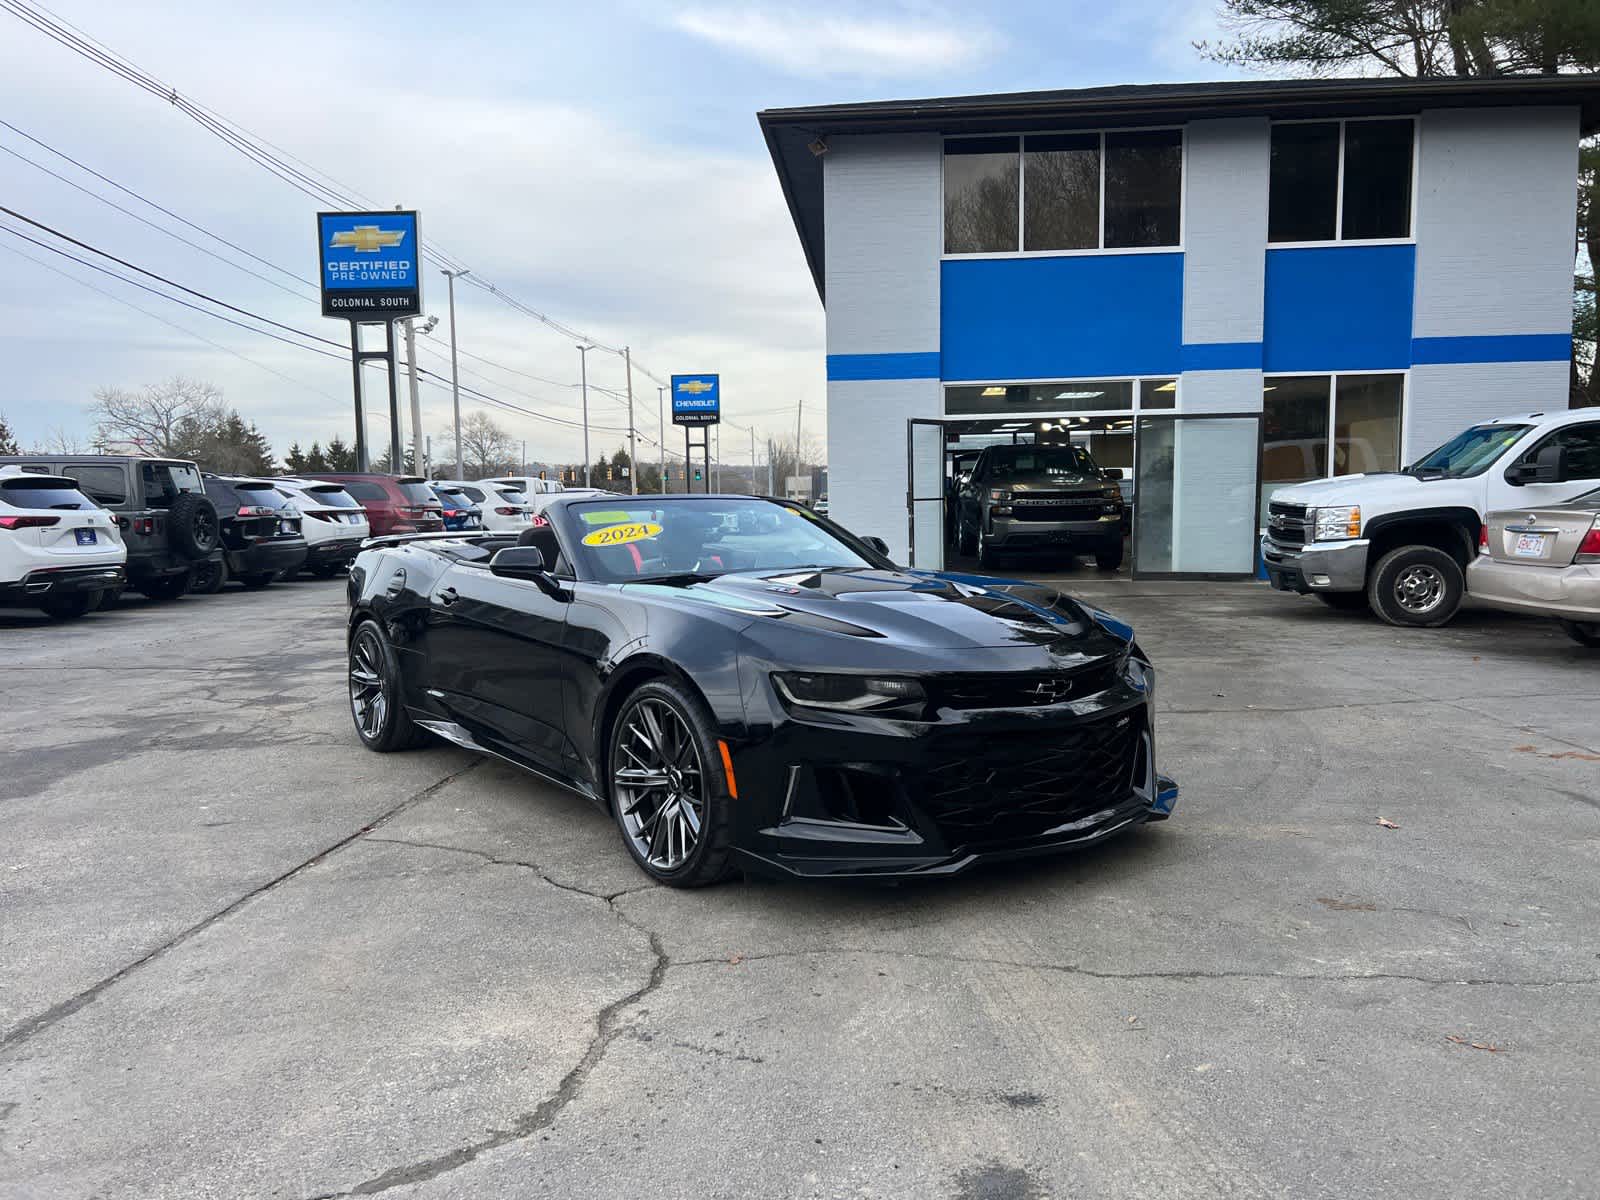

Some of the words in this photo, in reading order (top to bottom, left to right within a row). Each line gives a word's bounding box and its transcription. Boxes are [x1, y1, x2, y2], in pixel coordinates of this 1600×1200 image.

[327, 260, 410, 271] CERTIFIED
[332, 270, 407, 280] PRE-OWNED
[331, 298, 376, 307] COLONIAL
[380, 297, 409, 306] SOUTH
[599, 524, 649, 544] 2024
